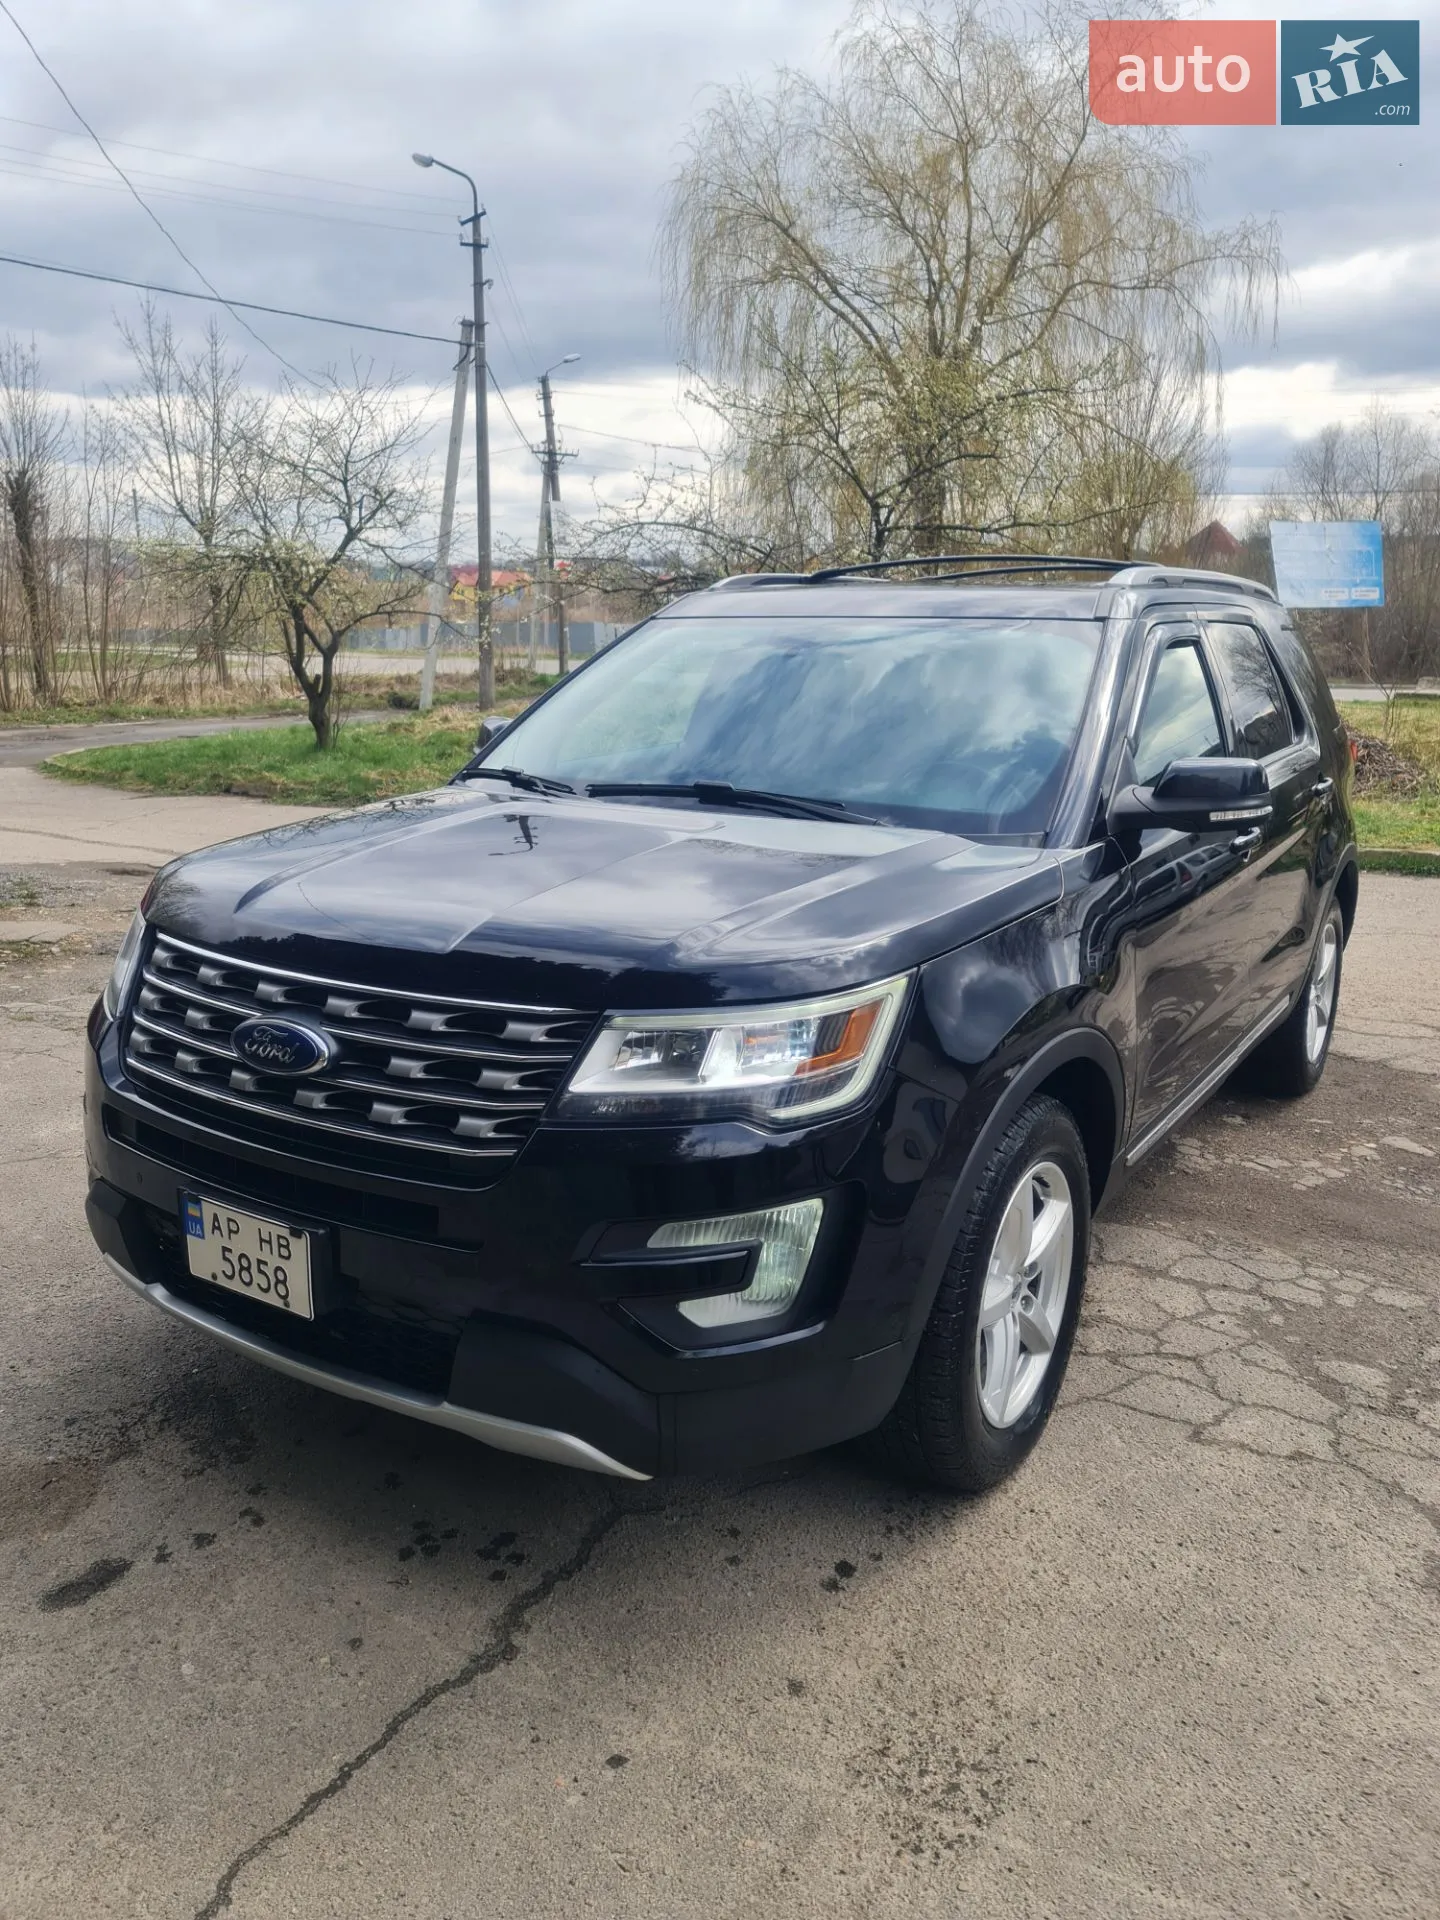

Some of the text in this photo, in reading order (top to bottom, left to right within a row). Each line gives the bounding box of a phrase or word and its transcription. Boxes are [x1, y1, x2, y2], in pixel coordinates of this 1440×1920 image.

[244, 1025, 301, 1065] Ford
[188, 1221, 203, 1238] UA
[211, 1212, 292, 1261] AP HB
[221, 1245, 290, 1301] 5858
